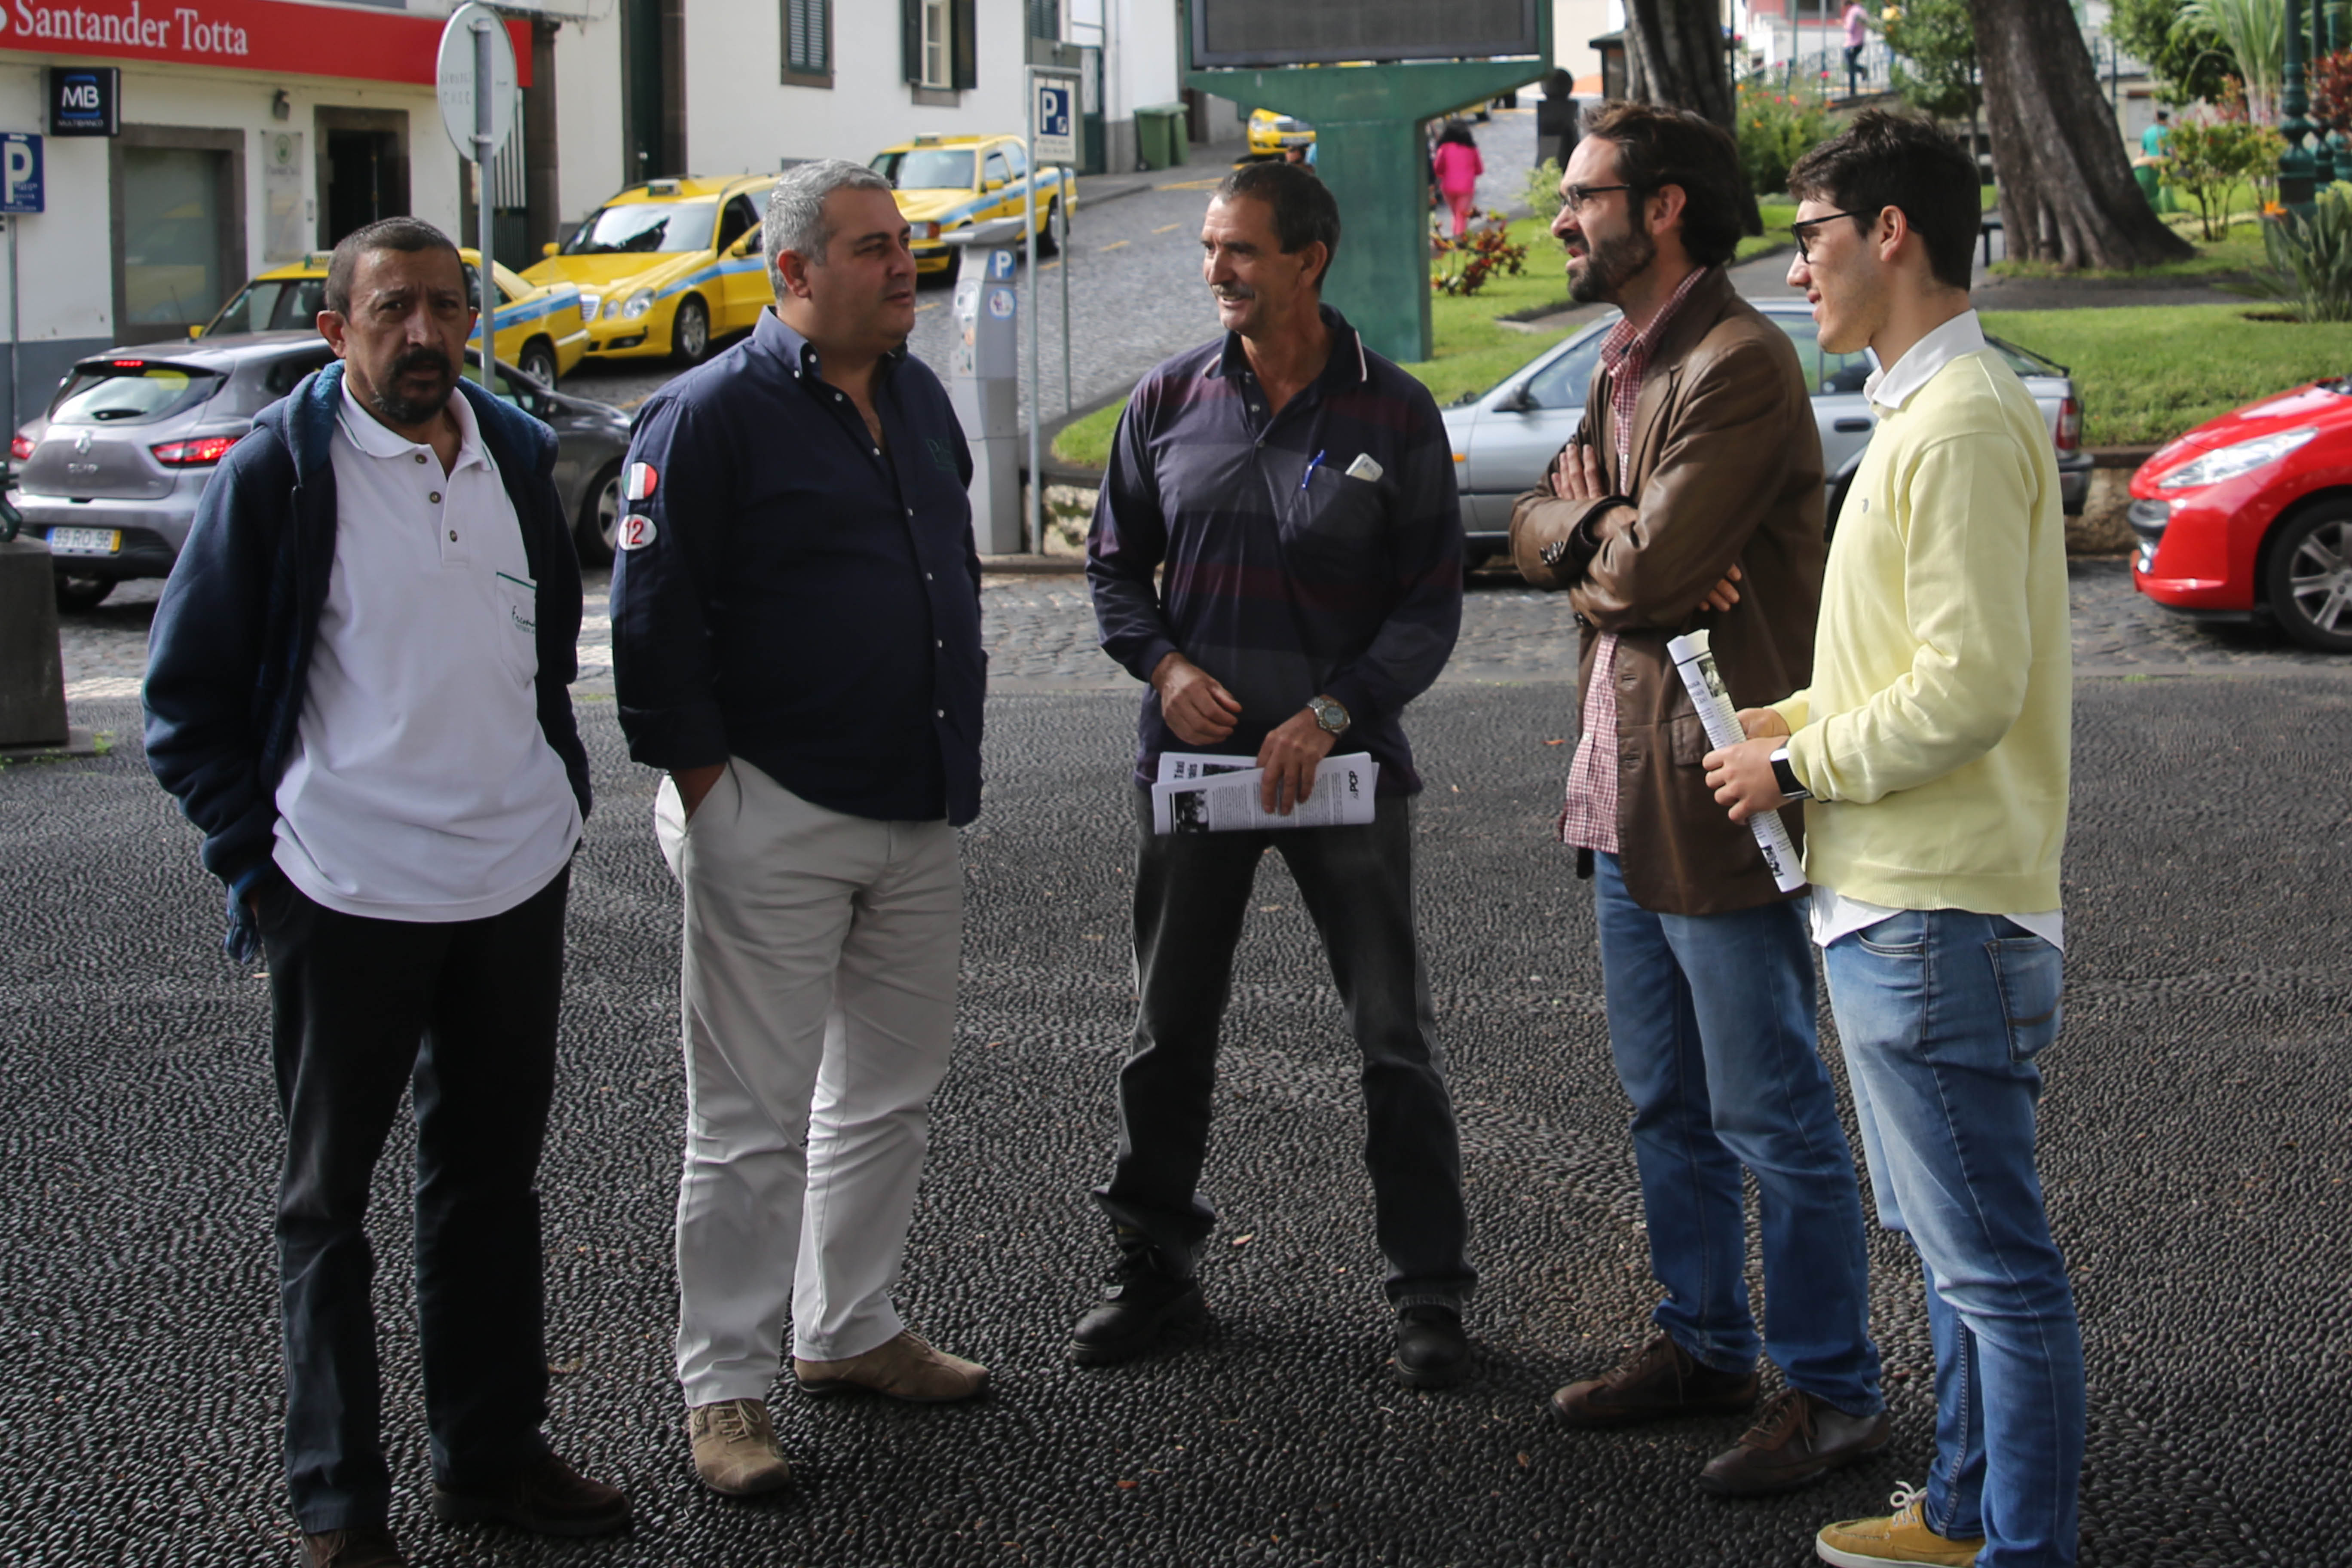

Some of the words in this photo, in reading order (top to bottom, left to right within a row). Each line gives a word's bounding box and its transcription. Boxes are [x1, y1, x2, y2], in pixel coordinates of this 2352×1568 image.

[15, 0, 170, 48] Santander
[175, 7, 248, 55] Totta
[62, 86, 99, 108] MB
[1042, 90, 1058, 131] P
[4, 141, 33, 203] P
[995, 251, 1012, 279] P
[626, 519, 644, 544] 12
[1349, 771, 1358, 792] PCP
